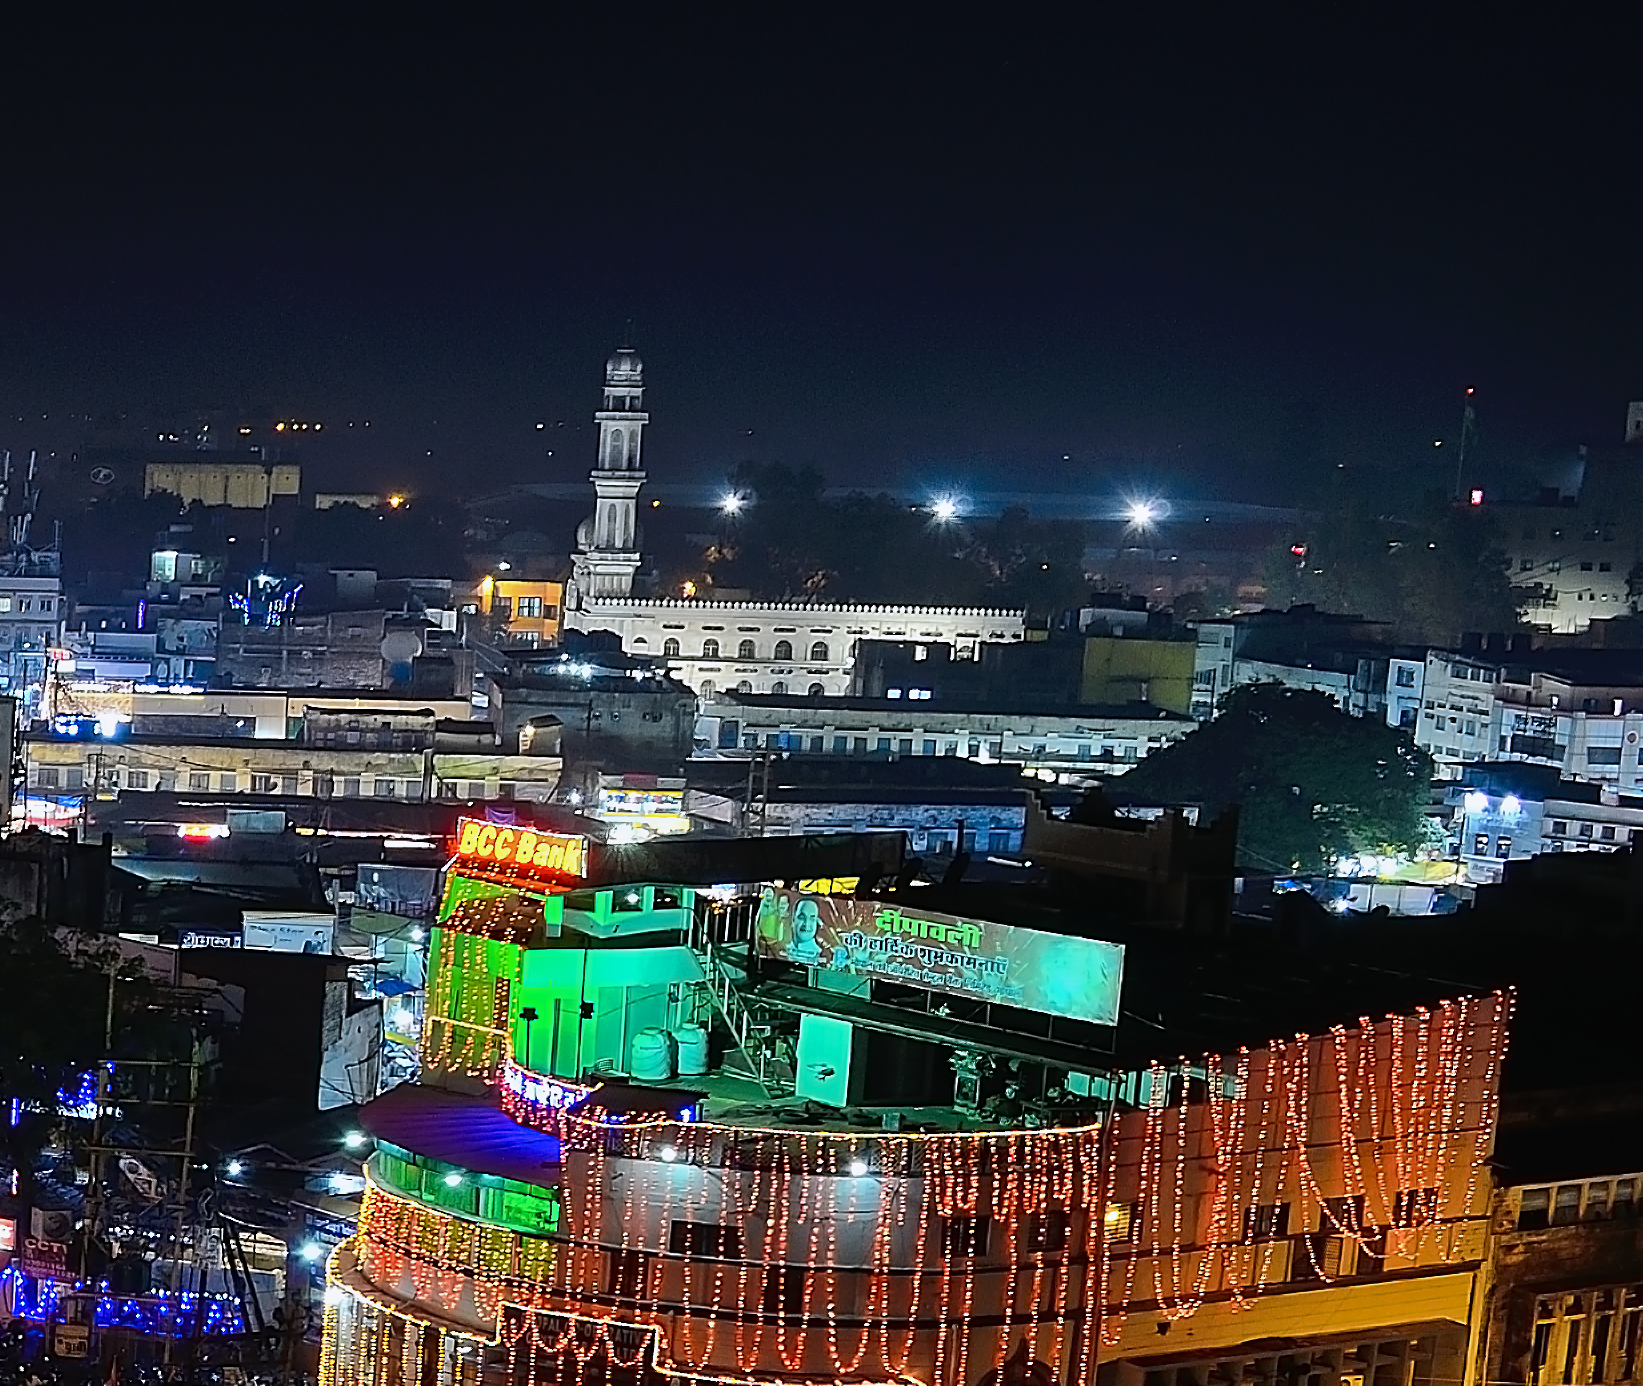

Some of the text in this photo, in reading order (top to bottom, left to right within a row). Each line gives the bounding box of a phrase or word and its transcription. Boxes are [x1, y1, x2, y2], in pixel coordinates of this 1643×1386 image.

[460, 823, 582, 873] BCC Bank
[844, 932, 865, 950] की
[868, 936, 916, 959] हार्दिक
[876, 909, 982, 948] दीपावली
